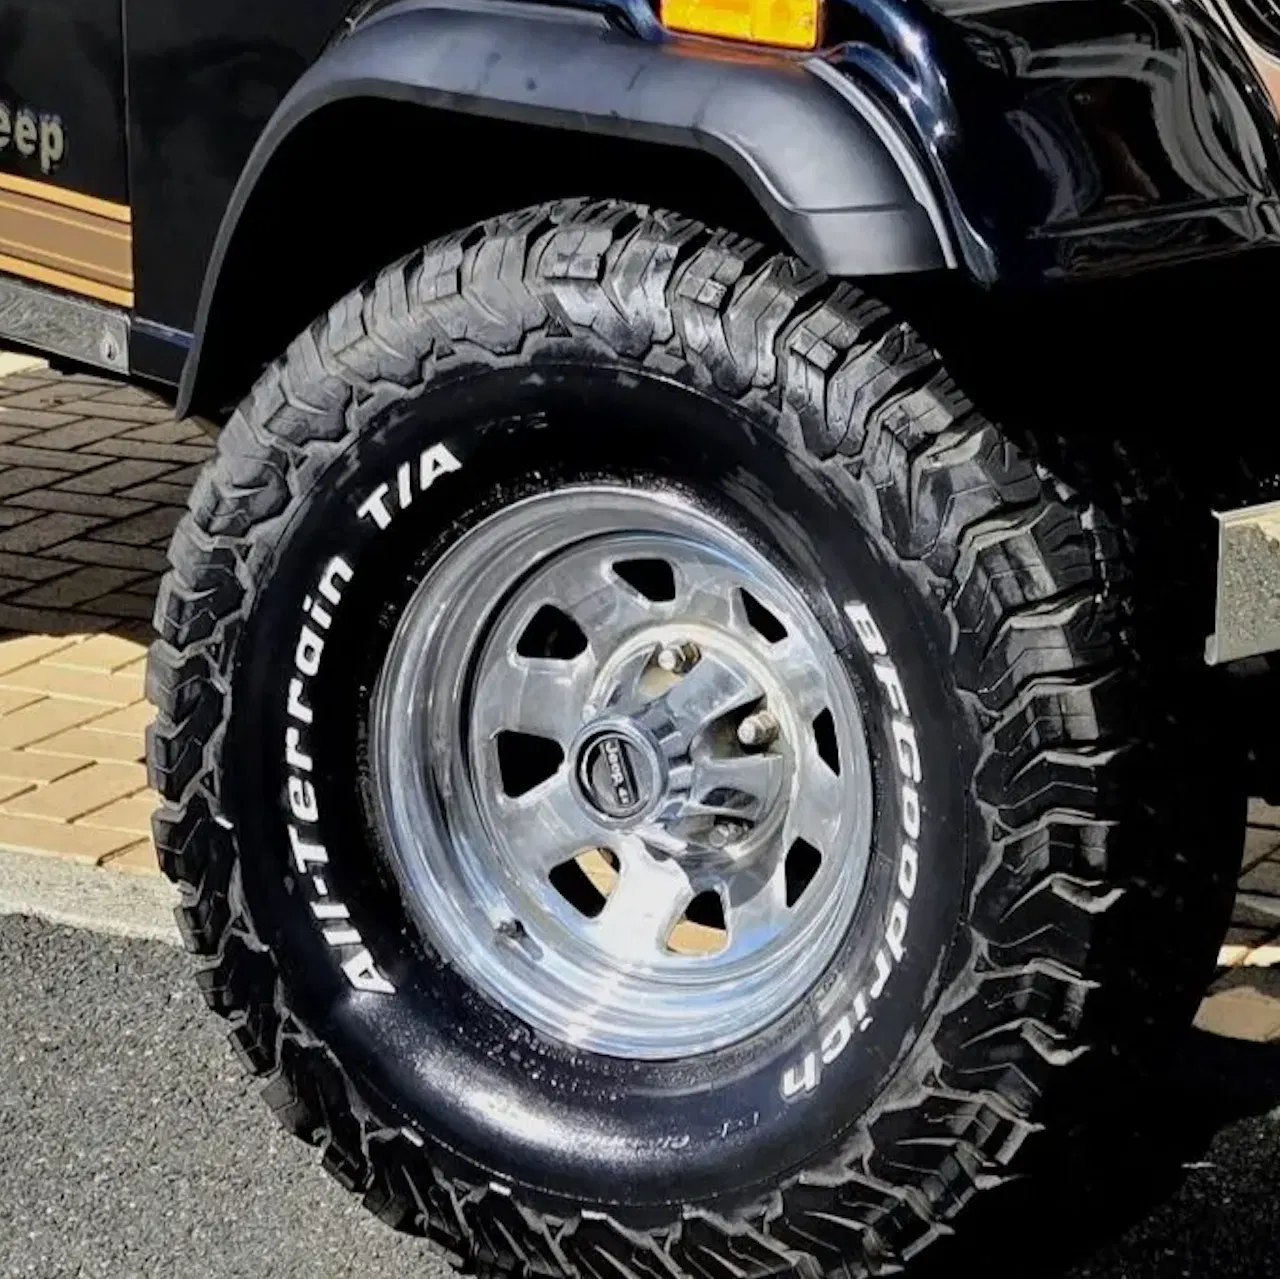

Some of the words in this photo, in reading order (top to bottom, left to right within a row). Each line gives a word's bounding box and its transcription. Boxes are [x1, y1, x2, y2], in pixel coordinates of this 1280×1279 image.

[285, 555, 397, 994] All-Terrain
[357, 441, 463, 531] T/A
[783, 600, 923, 1098] BFGoodrich
